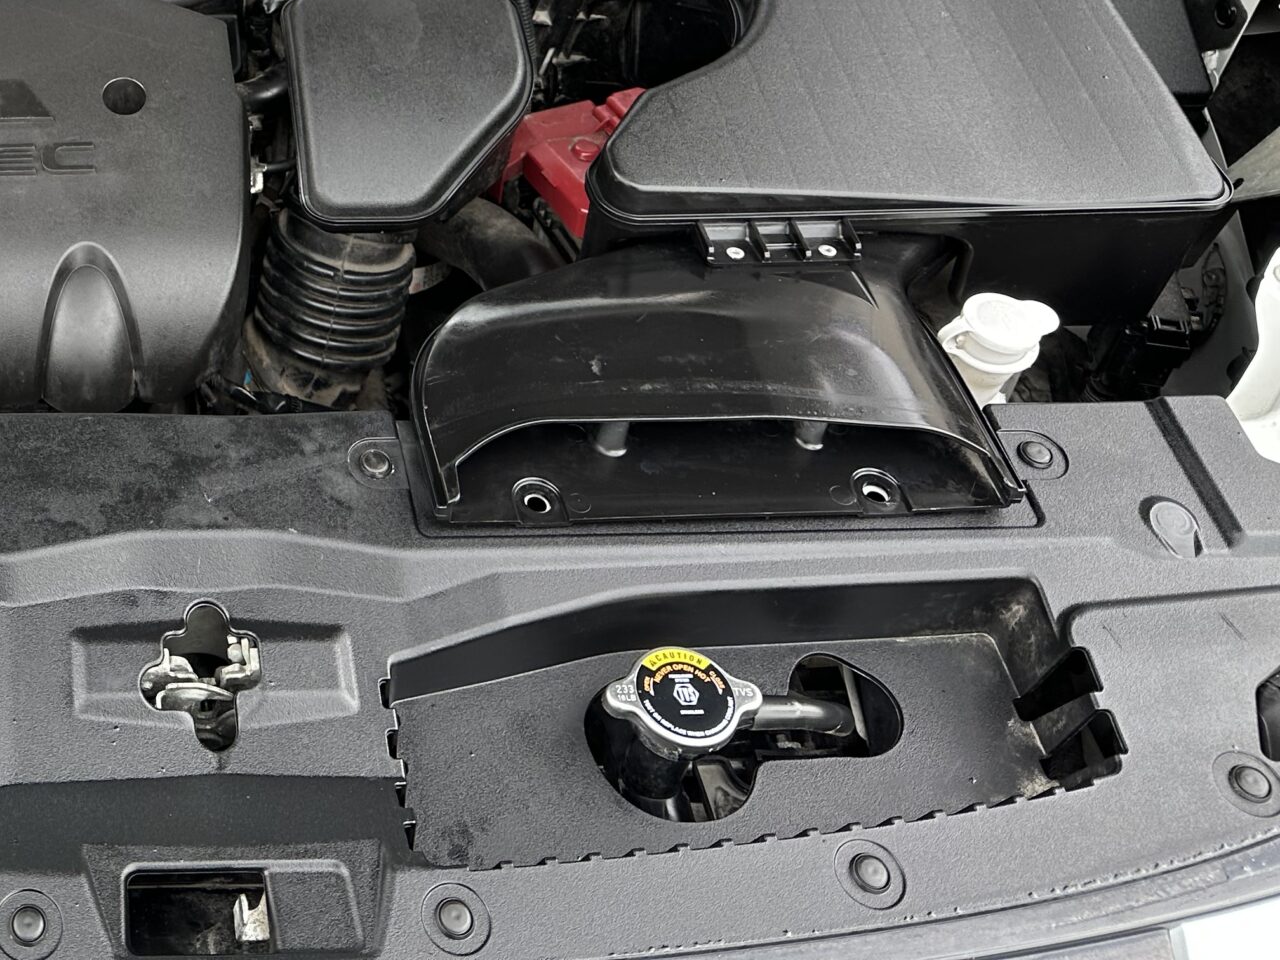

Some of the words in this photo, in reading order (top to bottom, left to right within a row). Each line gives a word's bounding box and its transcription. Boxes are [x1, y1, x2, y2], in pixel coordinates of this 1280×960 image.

[655, 651, 703, 666] CAUTION
[653, 665, 674, 684] NEVER
[672, 663, 694, 674] OPEN
[694, 668, 712, 683] HOT
[615, 684, 635, 694] 233
[733, 687, 754, 697] TVS
